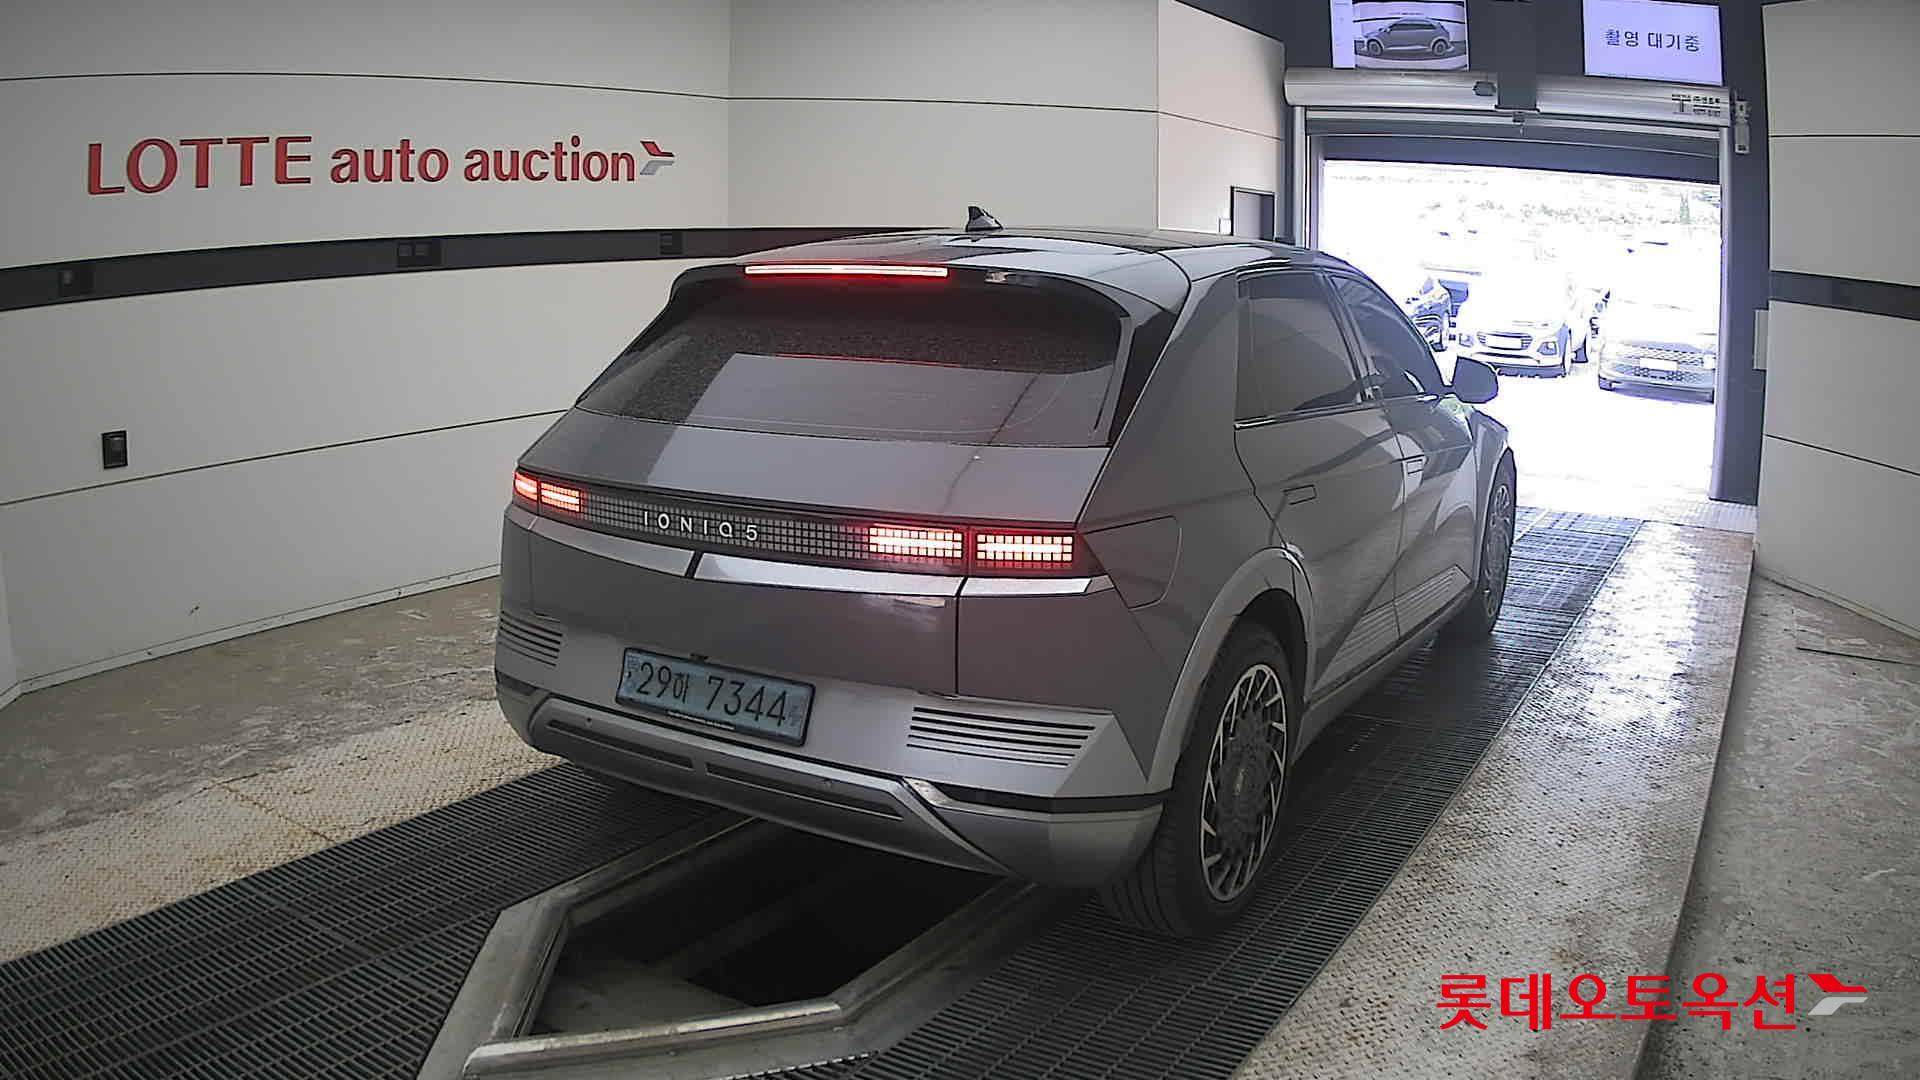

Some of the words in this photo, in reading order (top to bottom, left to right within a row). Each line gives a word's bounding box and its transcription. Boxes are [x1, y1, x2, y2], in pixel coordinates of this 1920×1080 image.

[1604, 28, 1639, 48] 촬영
[1647, 31, 1700, 52] 대기중
[88, 135, 312, 195] LOTTE
[329, 138, 449, 184] auto
[463, 135, 636, 182] auction
[643, 511, 733, 538] IONIQ
[745, 524, 758, 541] 5
[705, 675, 788, 727] 7344
